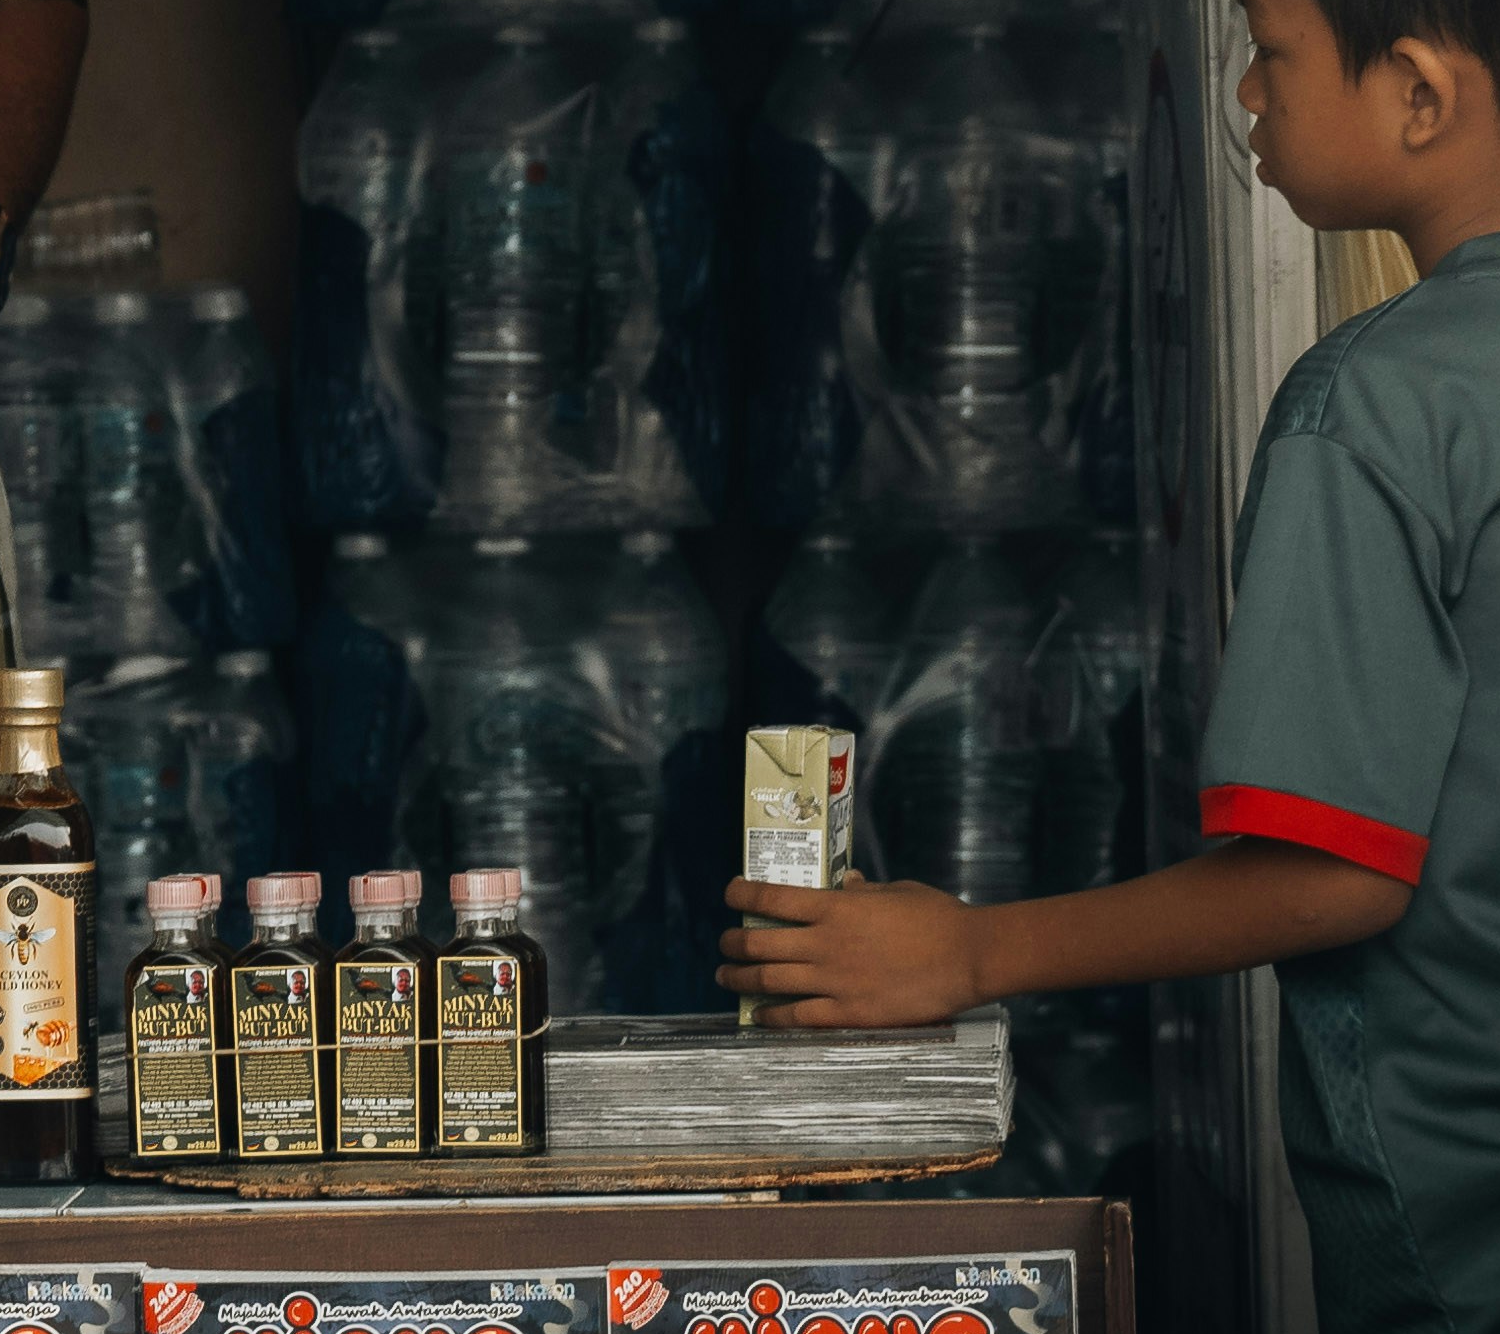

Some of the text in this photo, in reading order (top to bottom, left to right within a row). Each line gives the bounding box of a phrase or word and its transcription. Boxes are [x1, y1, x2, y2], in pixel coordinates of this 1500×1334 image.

[0, 969, 49, 980] CEYLON
[21, 979, 63, 990] HONEY
[138, 1003, 208, 1022] MINYAK
[239, 1003, 309, 1022] MINYAK
[342, 1000, 412, 1019] MINYAK
[444, 994, 513, 1013] MINYAK
[138, 1019, 207, 1037] BUT-BUT
[239, 1019, 307, 1037] BUT-BUT
[342, 1016, 411, 1034] BUT-BUT
[444, 1010, 512, 1028] BUT-BUT
[614, 1270, 642, 1302] 240
[149, 1282, 178, 1312] 240
[685, 1288, 988, 1311] Majalah Lawak Antarabangsa
[220, 1302, 521, 1321] Majalah Lawak Antarabangsa
